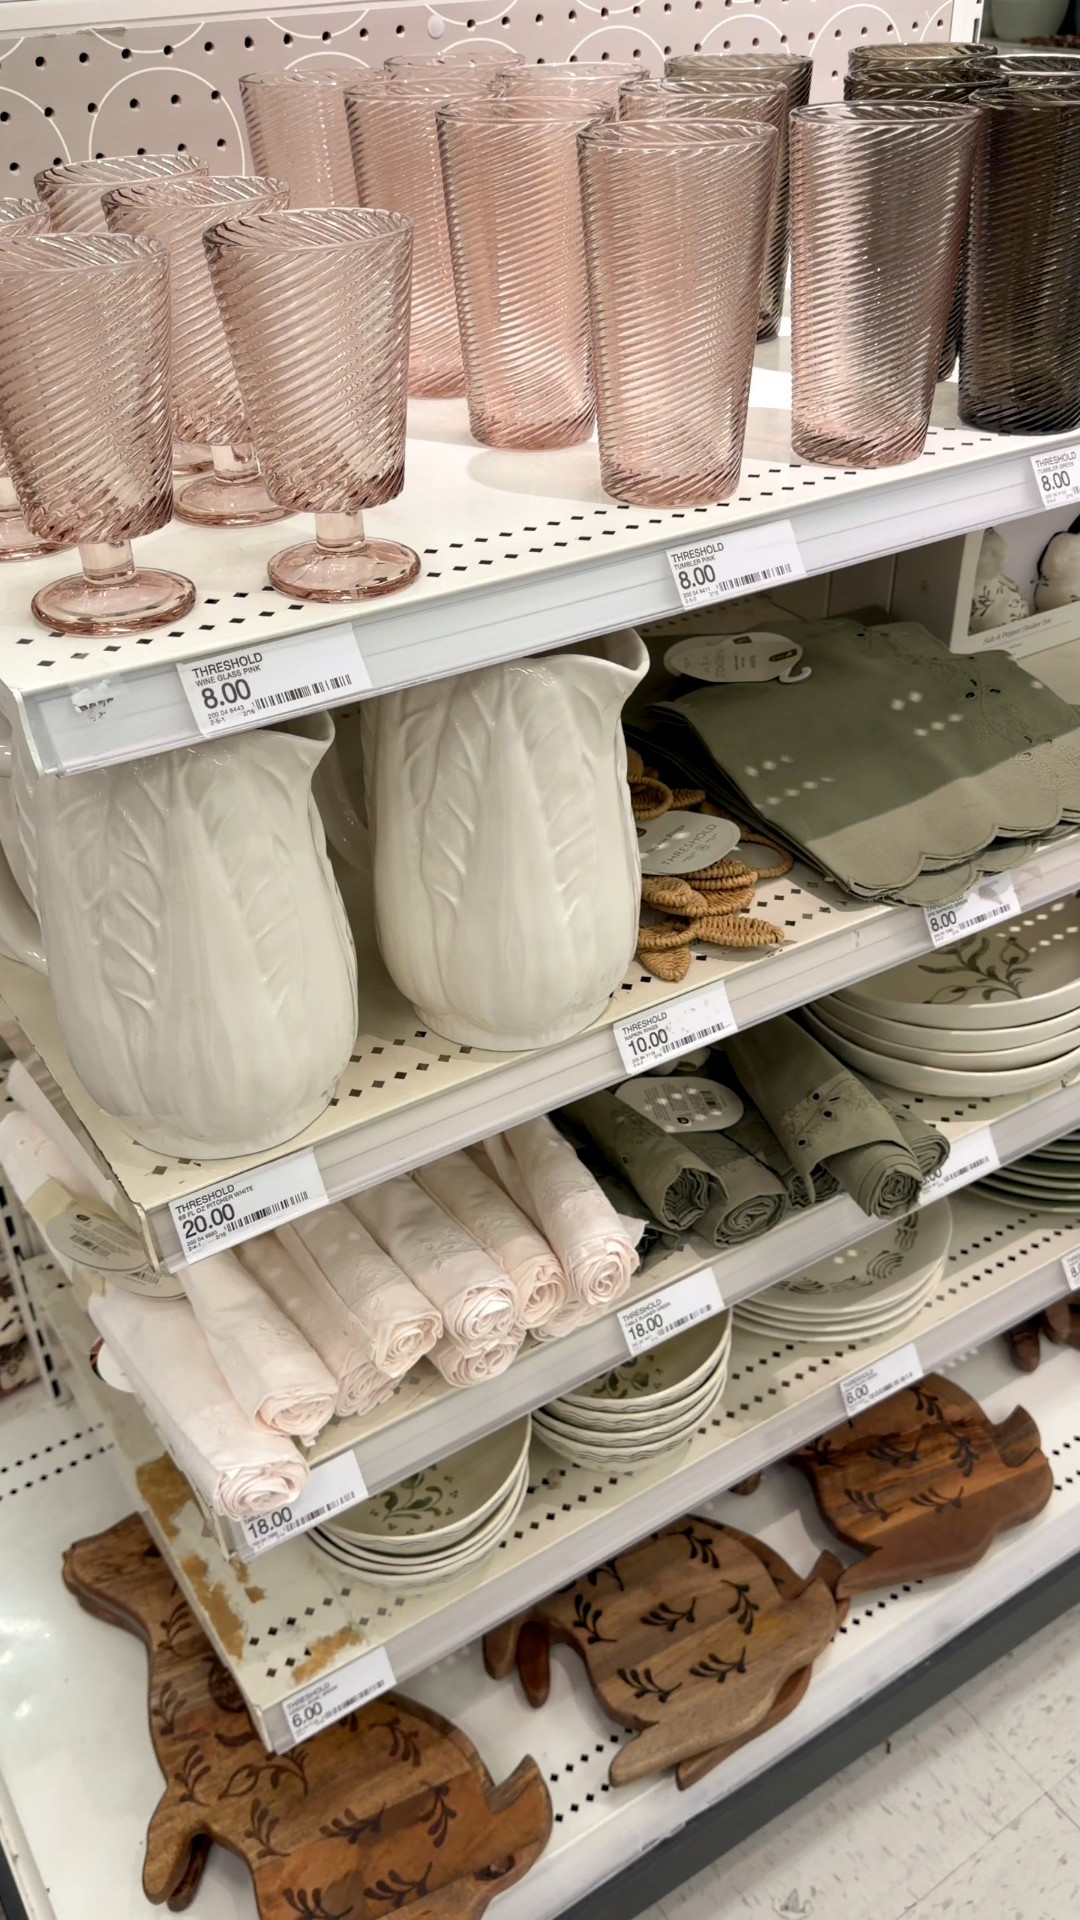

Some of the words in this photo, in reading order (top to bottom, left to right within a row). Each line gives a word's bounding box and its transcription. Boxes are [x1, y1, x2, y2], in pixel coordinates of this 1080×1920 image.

[1035, 452, 1077, 468] THRESHOLD
[1041, 470, 1071, 491] 8.00
[671, 542, 724, 563] THRESHOLD
[674, 558, 701, 570] TUMBLER
[701, 554, 716, 565] PINK
[678, 564, 716, 589] 8.00
[192, 652, 263, 679] THRESHOLD
[195, 676, 216, 687] WINE
[217, 670, 242, 682] GLASS
[243, 664, 261, 676] PINK
[201, 678, 251, 709] 8.00
[661, 824, 717, 866] THRESHOLD
[930, 910, 957, 932] 8.00
[621, 1012, 668, 1036] THRESHOLD
[628, 1028, 668, 1056] 10.00
[175, 1184, 235, 1215] THRESHOLD
[187, 1210, 196, 1219] FL
[196, 1206, 206, 1215] OZ
[206, 1194, 234, 1212] PITCHER
[234, 1185, 254, 1200] WHITE
[182, 1203, 235, 1239] 20.00
[622, 1298, 662, 1322] THRESHOLD
[628, 1313, 664, 1340] 18.00
[846, 1384, 869, 1404] 6.00
[248, 1506, 292, 1539] 18.00
[292, 1702, 323, 1728] 6.00
